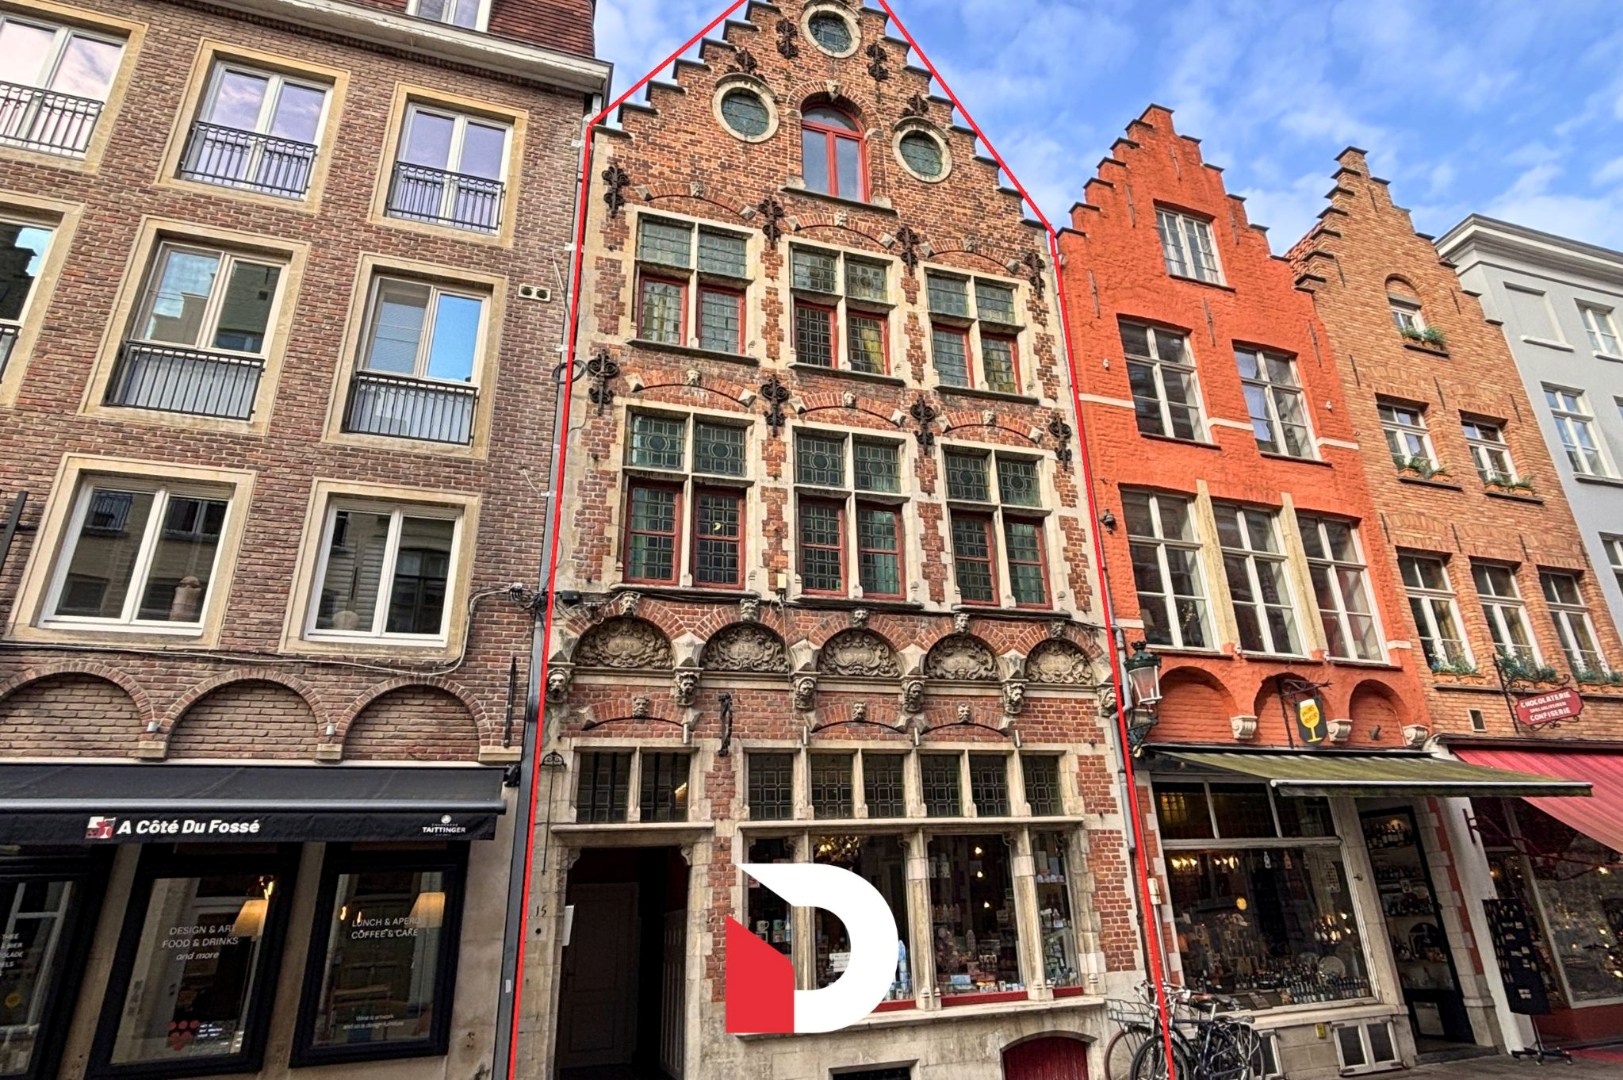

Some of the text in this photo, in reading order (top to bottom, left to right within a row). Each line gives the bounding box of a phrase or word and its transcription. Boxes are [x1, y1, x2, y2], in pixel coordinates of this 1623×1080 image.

[1520, 691, 1571, 708] CHOCOLATERIE
[1530, 707, 1571, 721] CONFISERIE
[116, 819, 261, 834] A Côté Du Fossé
[536, 905, 547, 917] 15
[352, 918, 382, 928] LUNCH
[384, 918, 391, 926] &
[169, 925, 207, 935] DESIGN
[209, 925, 216, 934] &
[351, 928, 419, 939] COFFEE & CAKE
[162, 937, 239, 948] FOOD & DRINKS
[176, 952, 220, 960] and more
